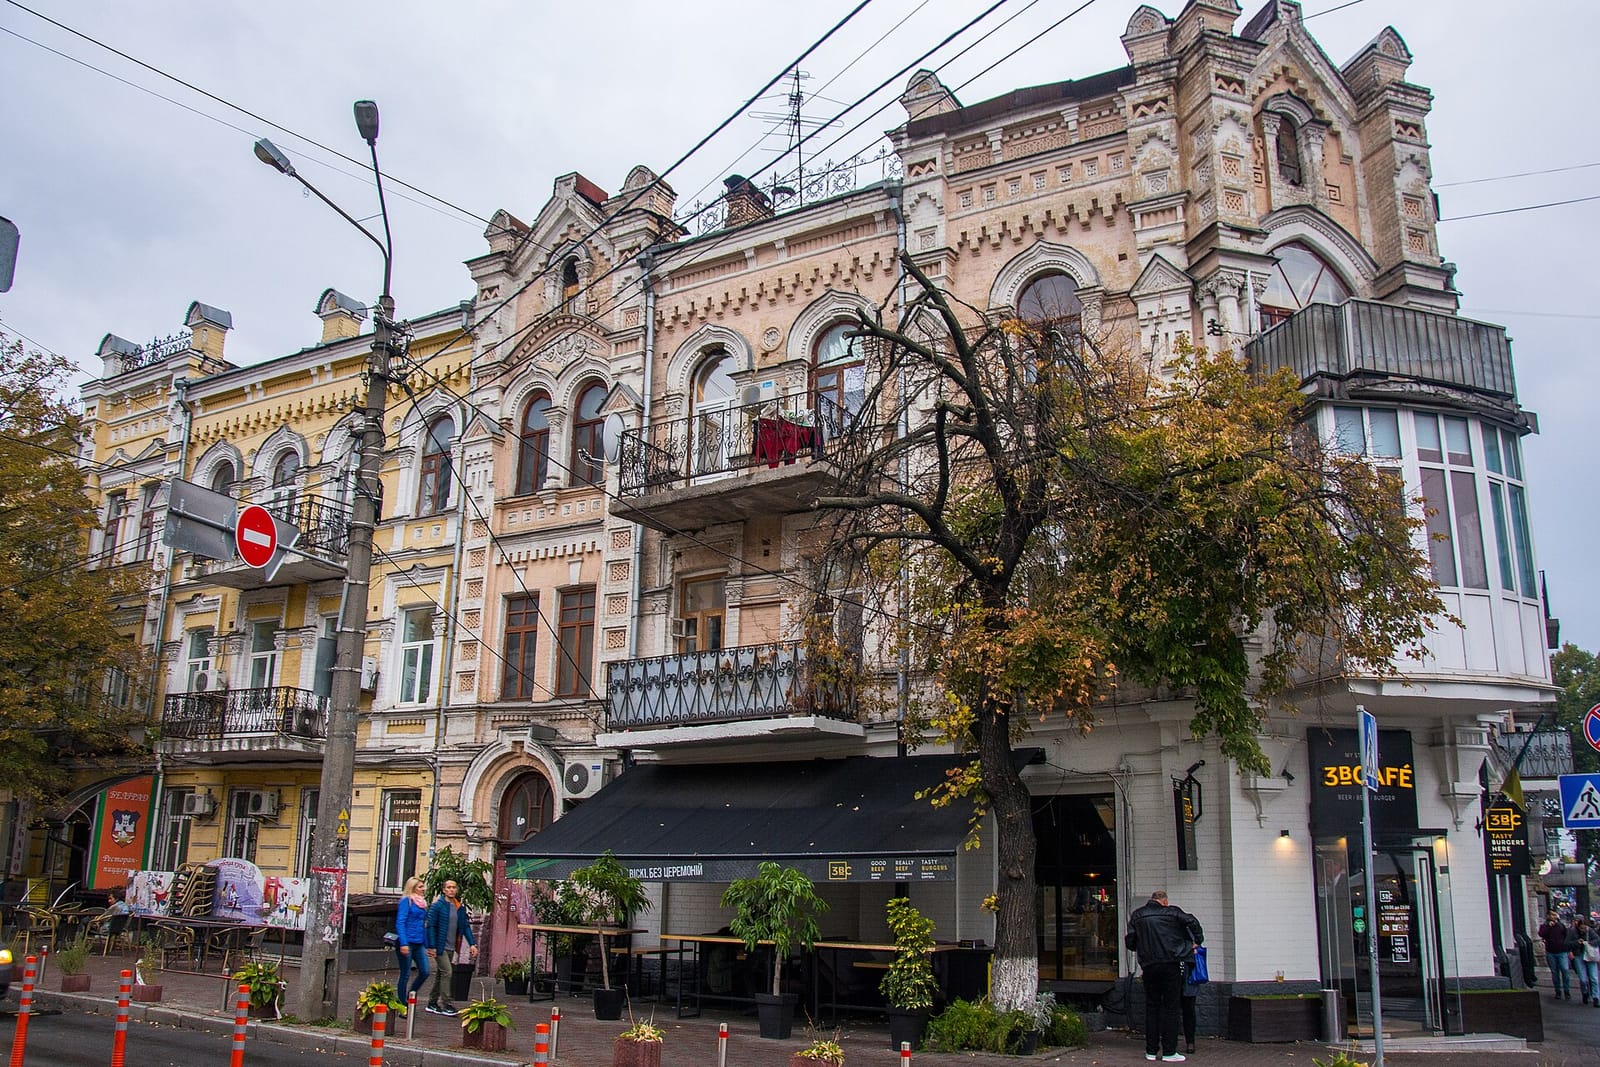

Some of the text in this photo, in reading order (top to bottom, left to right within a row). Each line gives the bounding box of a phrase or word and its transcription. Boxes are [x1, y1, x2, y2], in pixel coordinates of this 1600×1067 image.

[1490, 814, 1522, 826] 3BC
[649, 867, 662, 879] БЕЗ
[663, 862, 703, 879] ЦЕРЕМОНІЙ
[831, 866, 852, 876] 3BC
